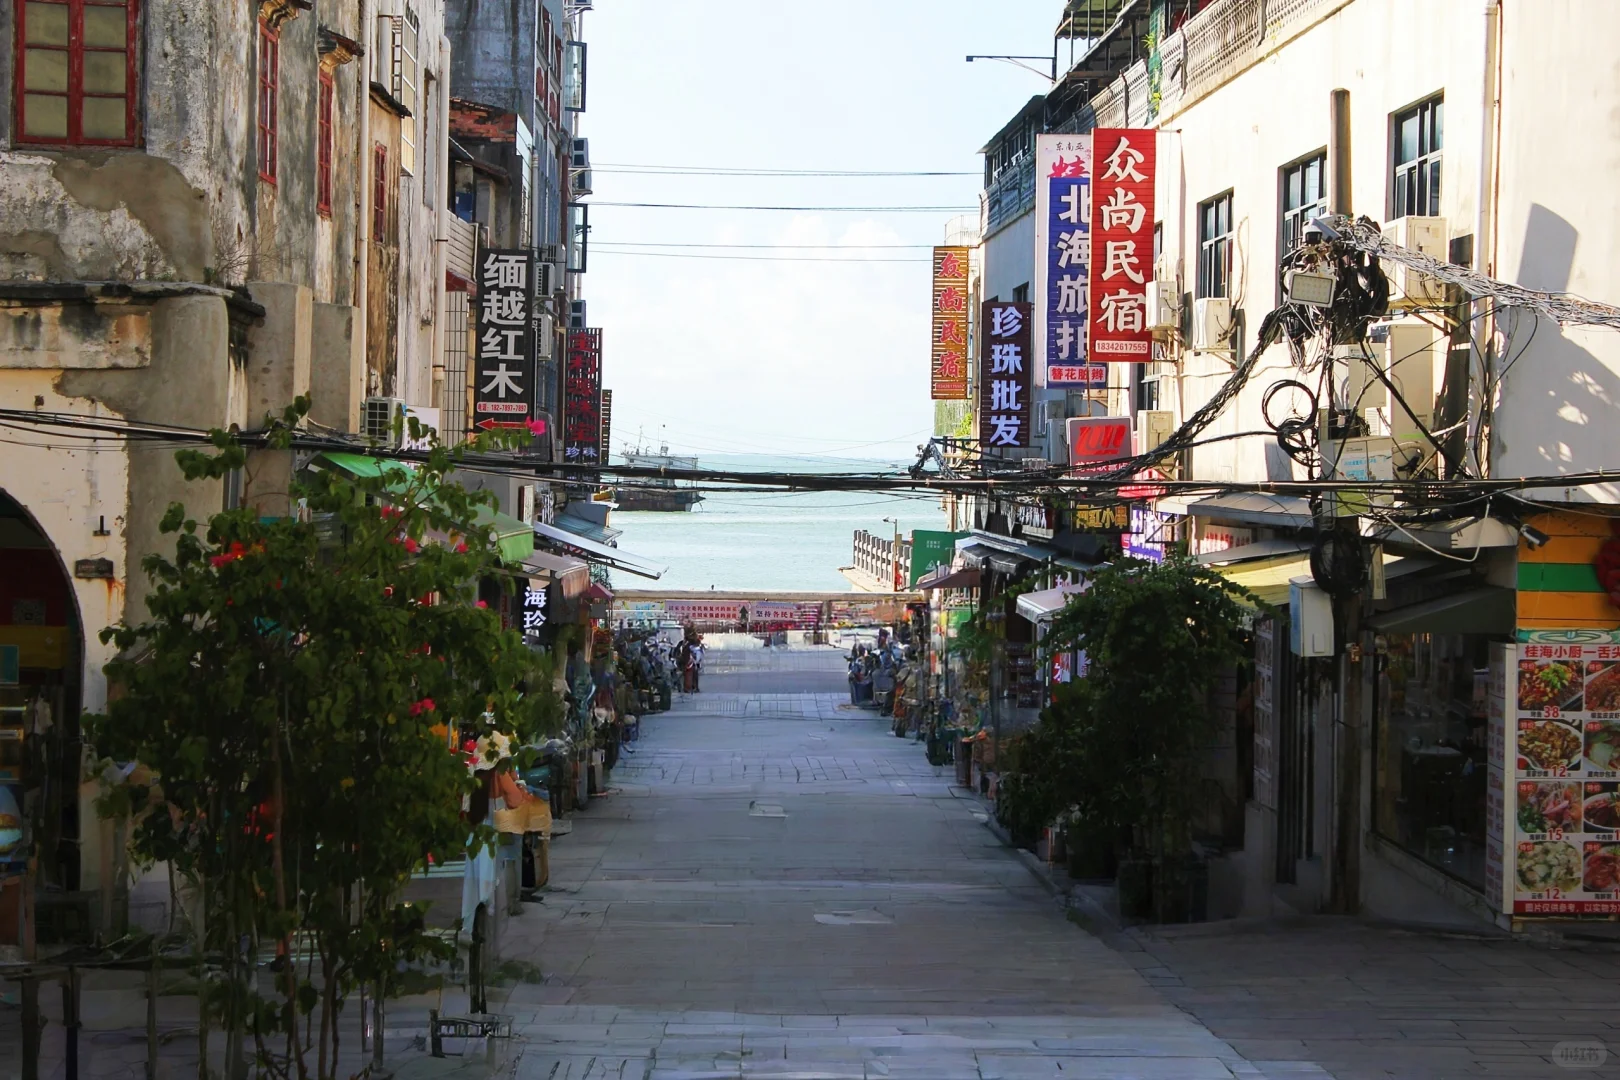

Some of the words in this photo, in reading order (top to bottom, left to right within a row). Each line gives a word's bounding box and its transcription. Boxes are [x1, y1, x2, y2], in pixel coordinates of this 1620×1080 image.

[1055, 141, 1085, 151] 东南亚
[1096, 136, 1149, 333] 众尚民宿
[1057, 185, 1090, 360] 北海旅拍
[937, 252, 964, 378] 众尚民宿
[481, 253, 528, 399] 缅越红木
[1096, 341, 1147, 352] 18342617555
[990, 306, 1023, 446] 珍珠批发
[1051, 367, 1104, 380] 簪花脏辫
[565, 446, 598, 458] 珍珠
[522, 586, 548, 632] 海珍
[1544, 706, 1560, 718] 38
[1552, 766, 1566, 777] 12
[1548, 829, 1563, 840] 15
[1545, 888, 1560, 899] 12
